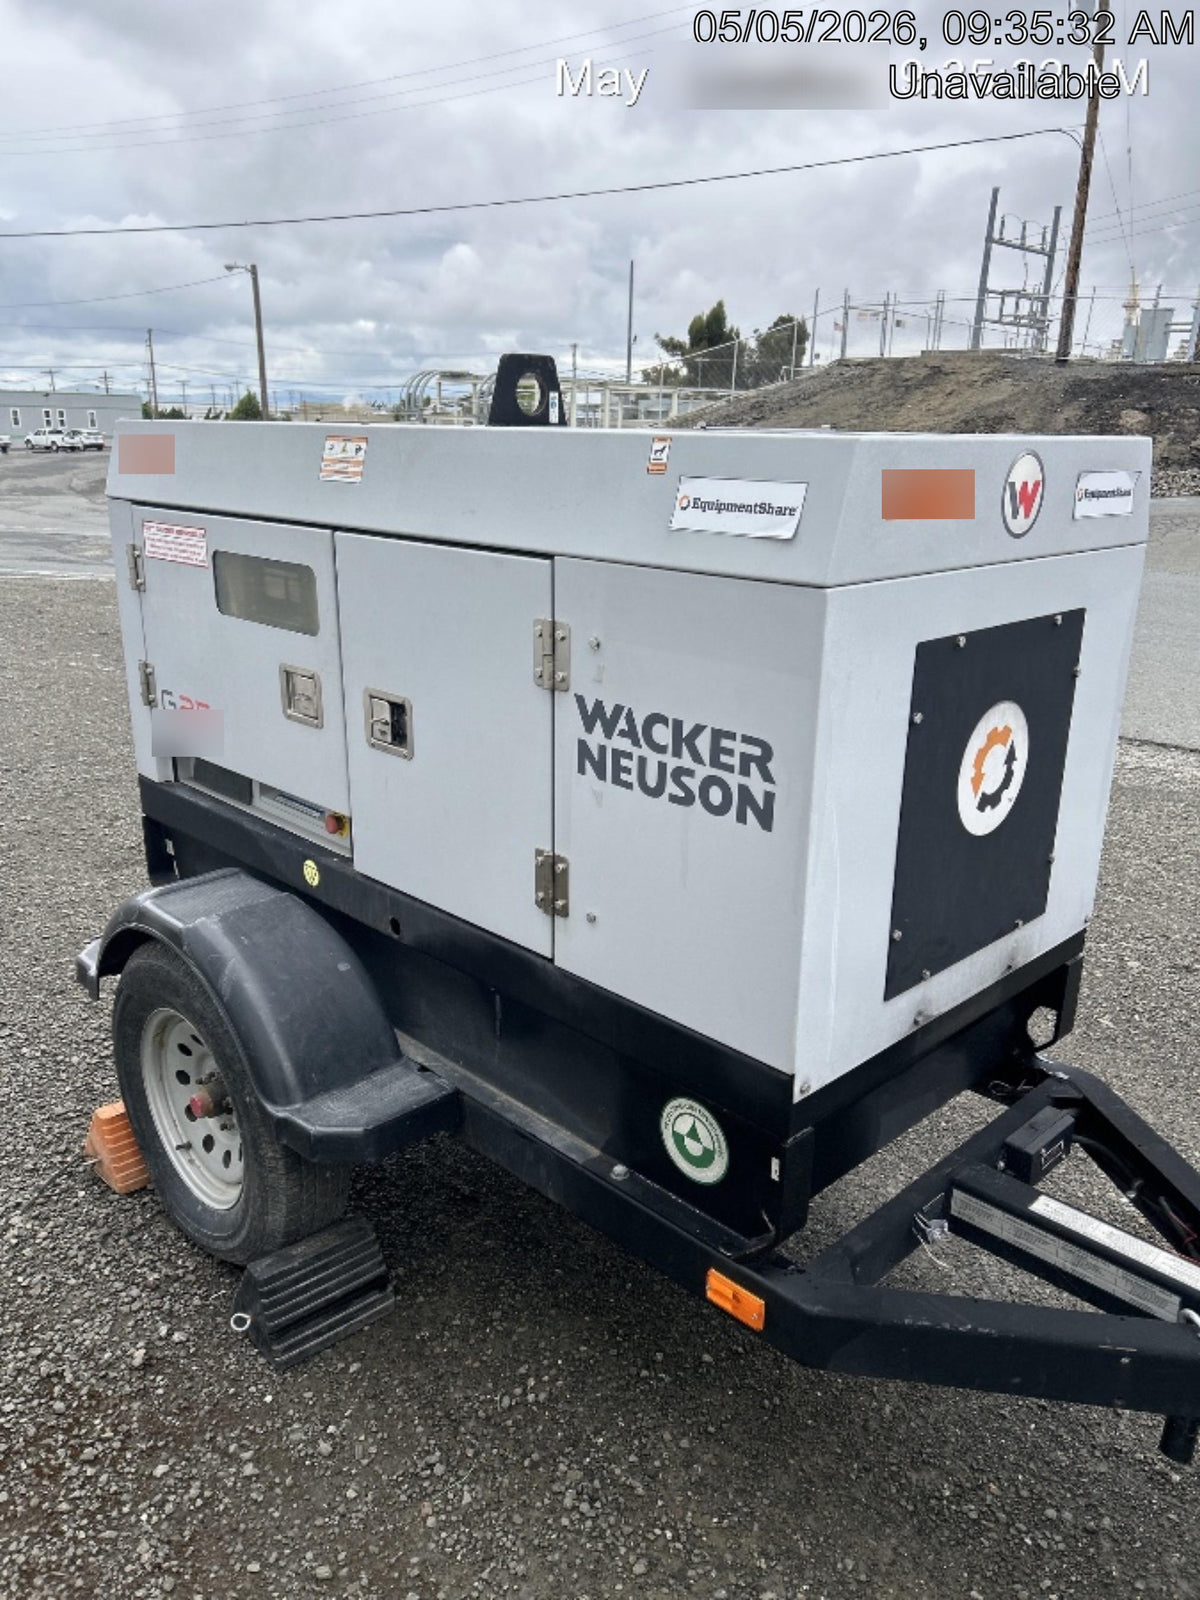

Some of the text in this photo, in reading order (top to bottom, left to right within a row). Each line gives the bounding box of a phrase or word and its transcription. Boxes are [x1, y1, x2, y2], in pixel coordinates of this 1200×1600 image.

[691, 497, 798, 516] EquipmentShare
[574, 692, 776, 785] WACKER
[577, 737, 776, 833] NEUSON
